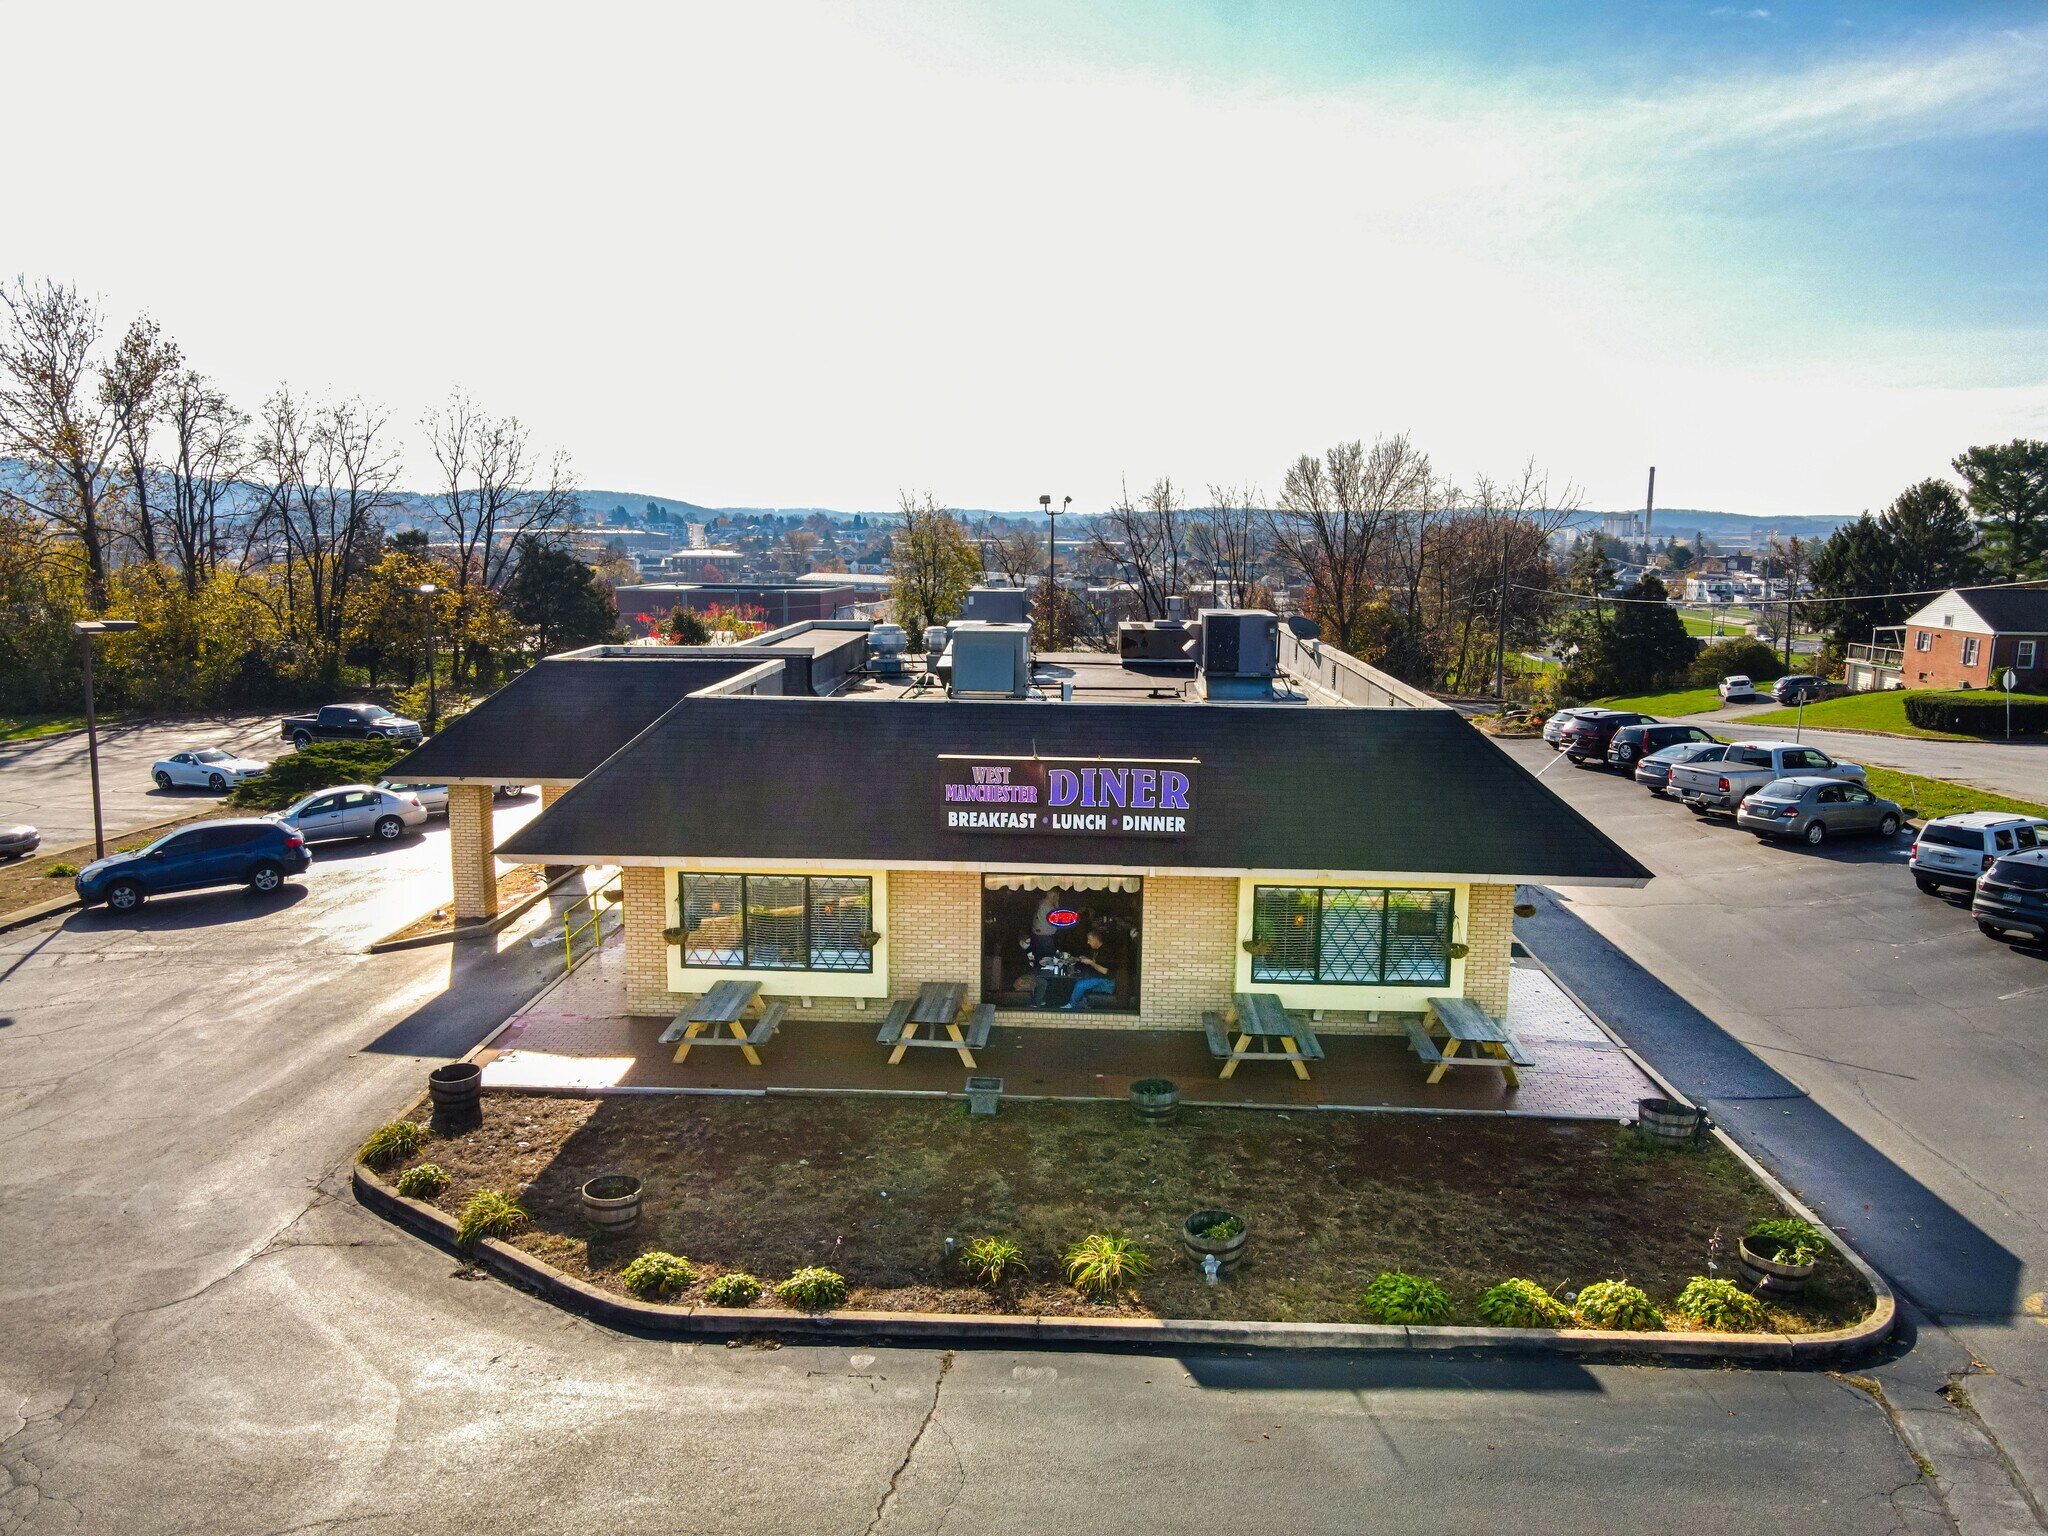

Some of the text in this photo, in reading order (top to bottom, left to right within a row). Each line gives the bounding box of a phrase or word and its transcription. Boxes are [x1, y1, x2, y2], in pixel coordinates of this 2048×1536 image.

[972, 766, 1011, 785] WEST
[945, 784, 1037, 803] MANCHESTER
[1048, 768, 1190, 809] DINER
[948, 811, 1186, 832] BREAKFAST LUNCH DINNER
